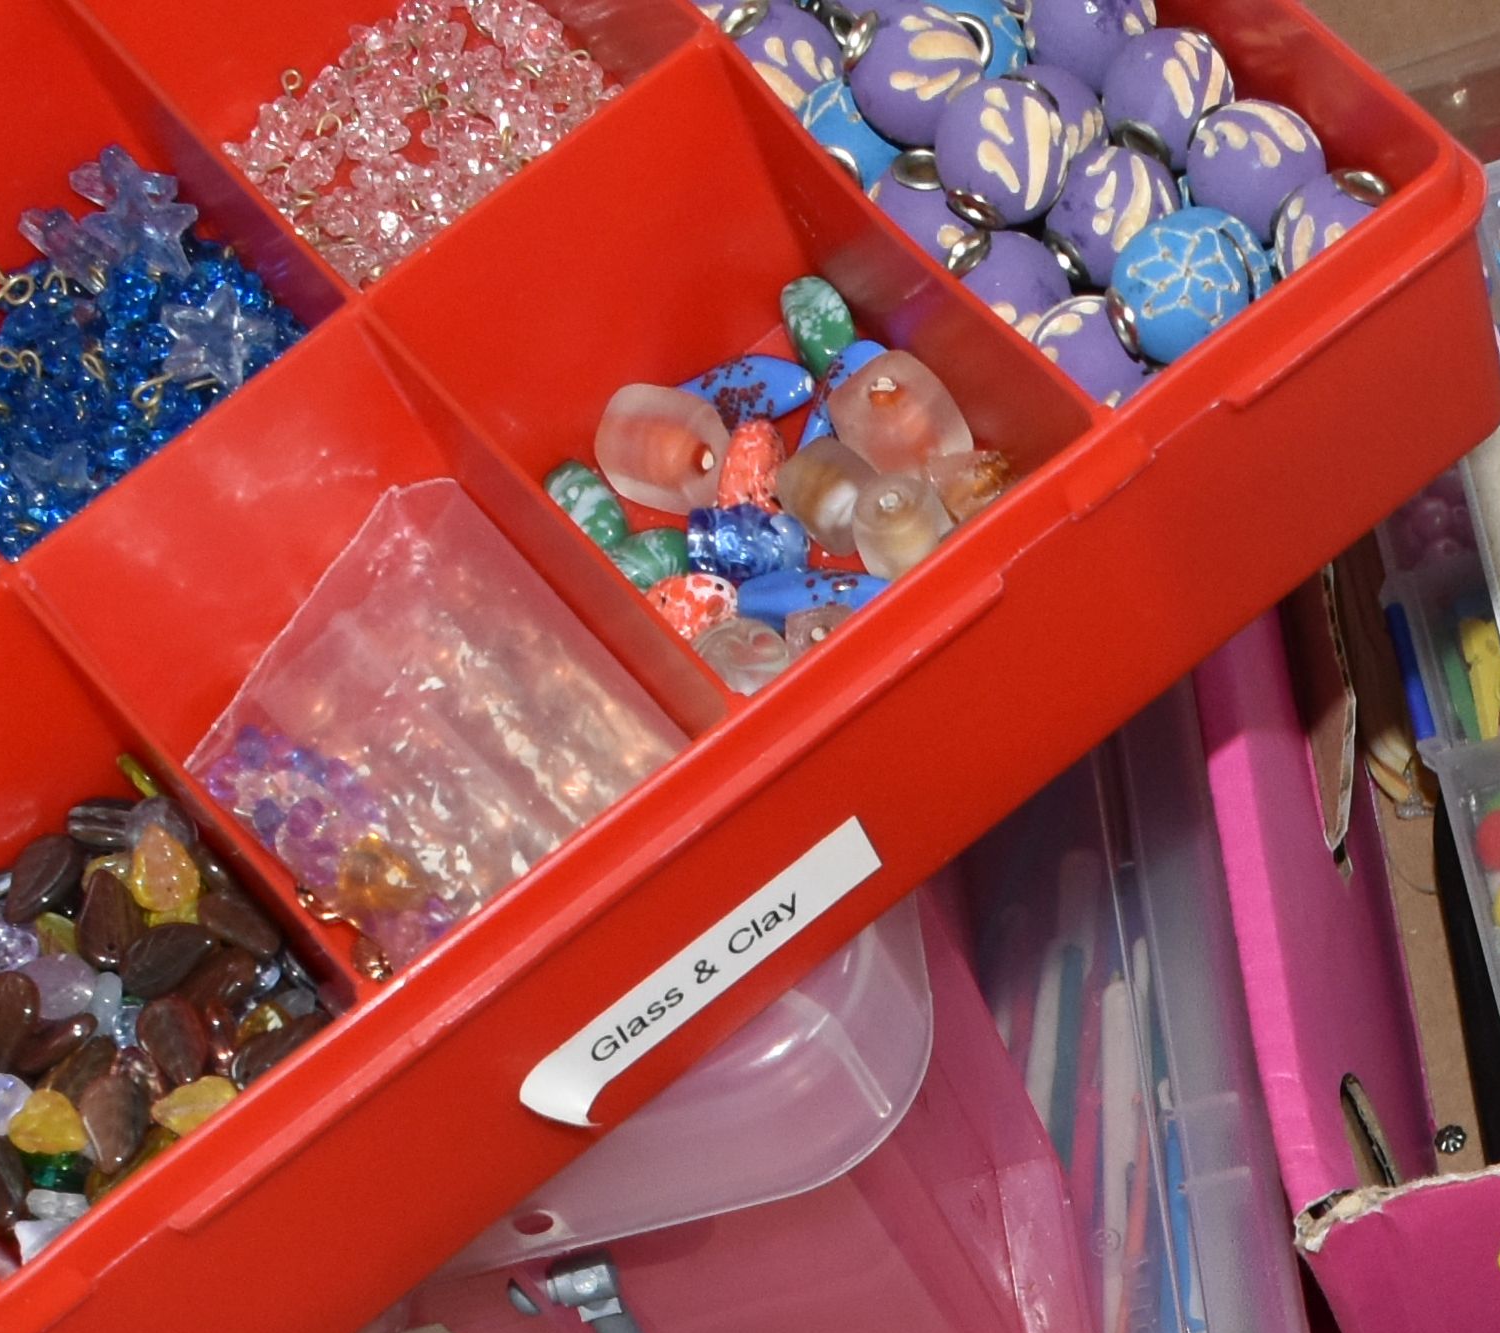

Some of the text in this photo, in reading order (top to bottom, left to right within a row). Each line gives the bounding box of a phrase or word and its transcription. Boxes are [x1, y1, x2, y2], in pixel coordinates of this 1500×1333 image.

[591, 891, 797, 1062] Glass & Clay
